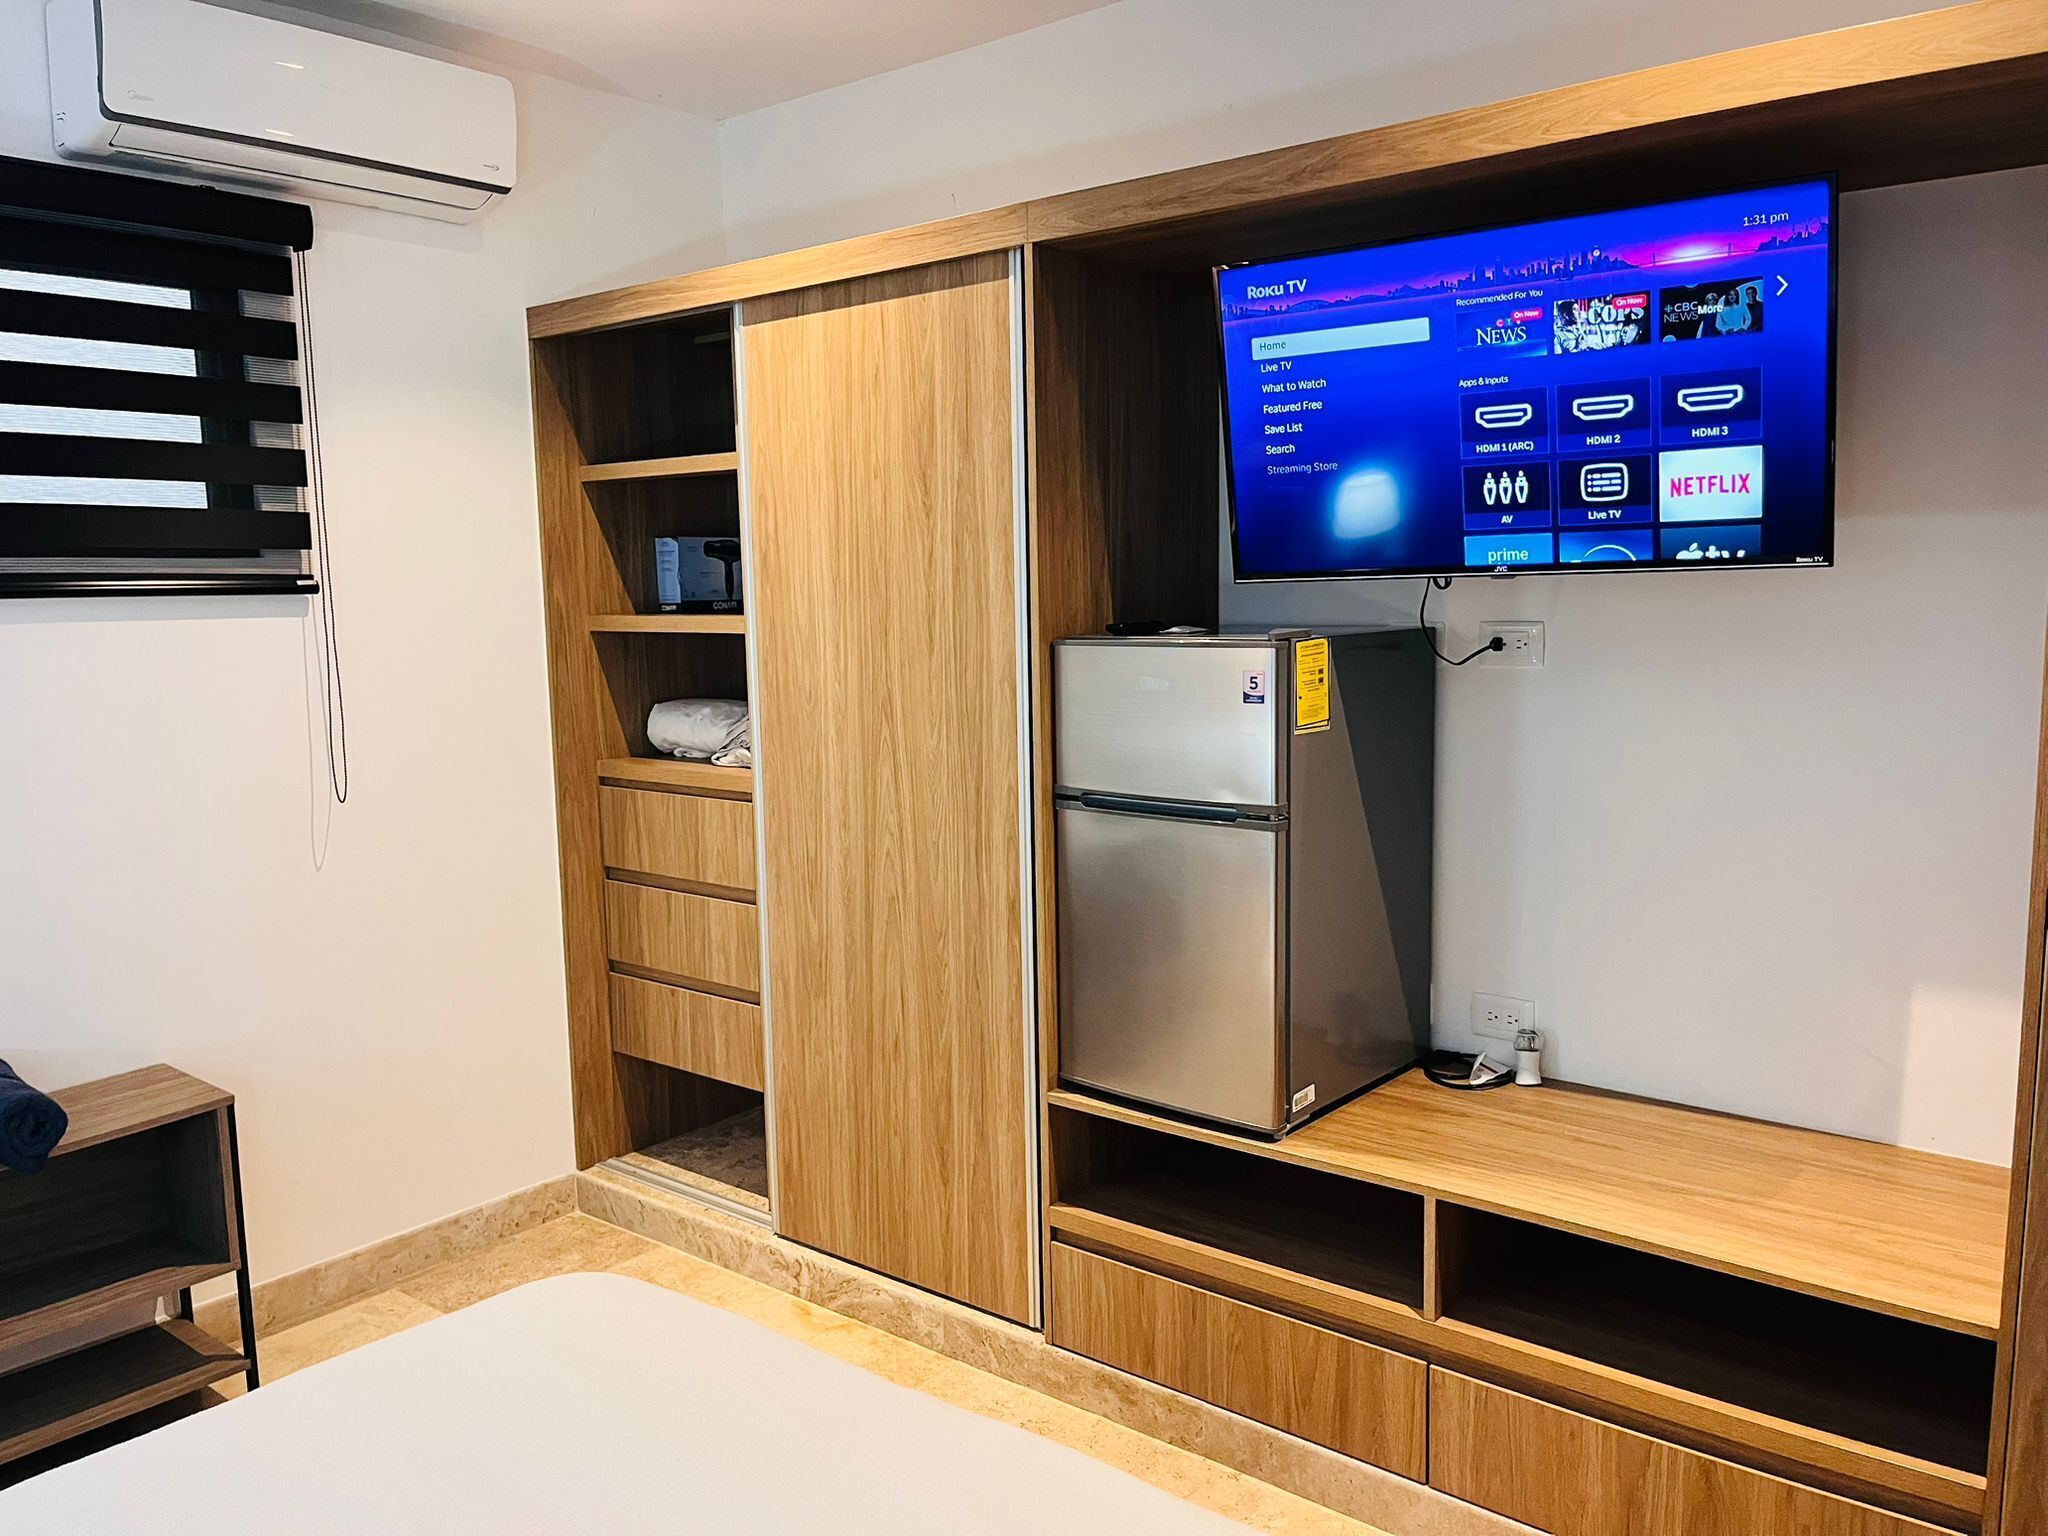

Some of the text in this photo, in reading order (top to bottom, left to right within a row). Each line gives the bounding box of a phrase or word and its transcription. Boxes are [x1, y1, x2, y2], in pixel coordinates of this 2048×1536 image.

[1743, 213, 1789, 227] 1:31 pm
[1286, 278, 1308, 295] TV
[1456, 289, 1543, 306] Recommended For You
[1674, 301, 1698, 312] CBC
[1698, 303, 1724, 315] More
[1664, 310, 1698, 323] NEWS
[1260, 339, 1287, 352] Home
[1261, 361, 1292, 373] Live TV
[1262, 379, 1326, 393] What to Watch
[1459, 376, 1508, 388] Apps & Inputs
[1263, 400, 1323, 414] Featured Free
[1264, 422, 1303, 435] Save List
[1691, 426, 1729, 438] HDMI 3
[1586, 434, 1621, 446] HDMI 2
[1266, 443, 1295, 455] Search
[1476, 441, 1534, 453] HDMI 1 (ARC)
[1267, 461, 1338, 475] Streaming Store
[1670, 473, 1751, 498] NETFLIX
[1501, 515, 1513, 524] AV
[1588, 509, 1621, 520] Live TV
[1488, 547, 1529, 565] prime
[1249, 676, 1258, 690] 5
